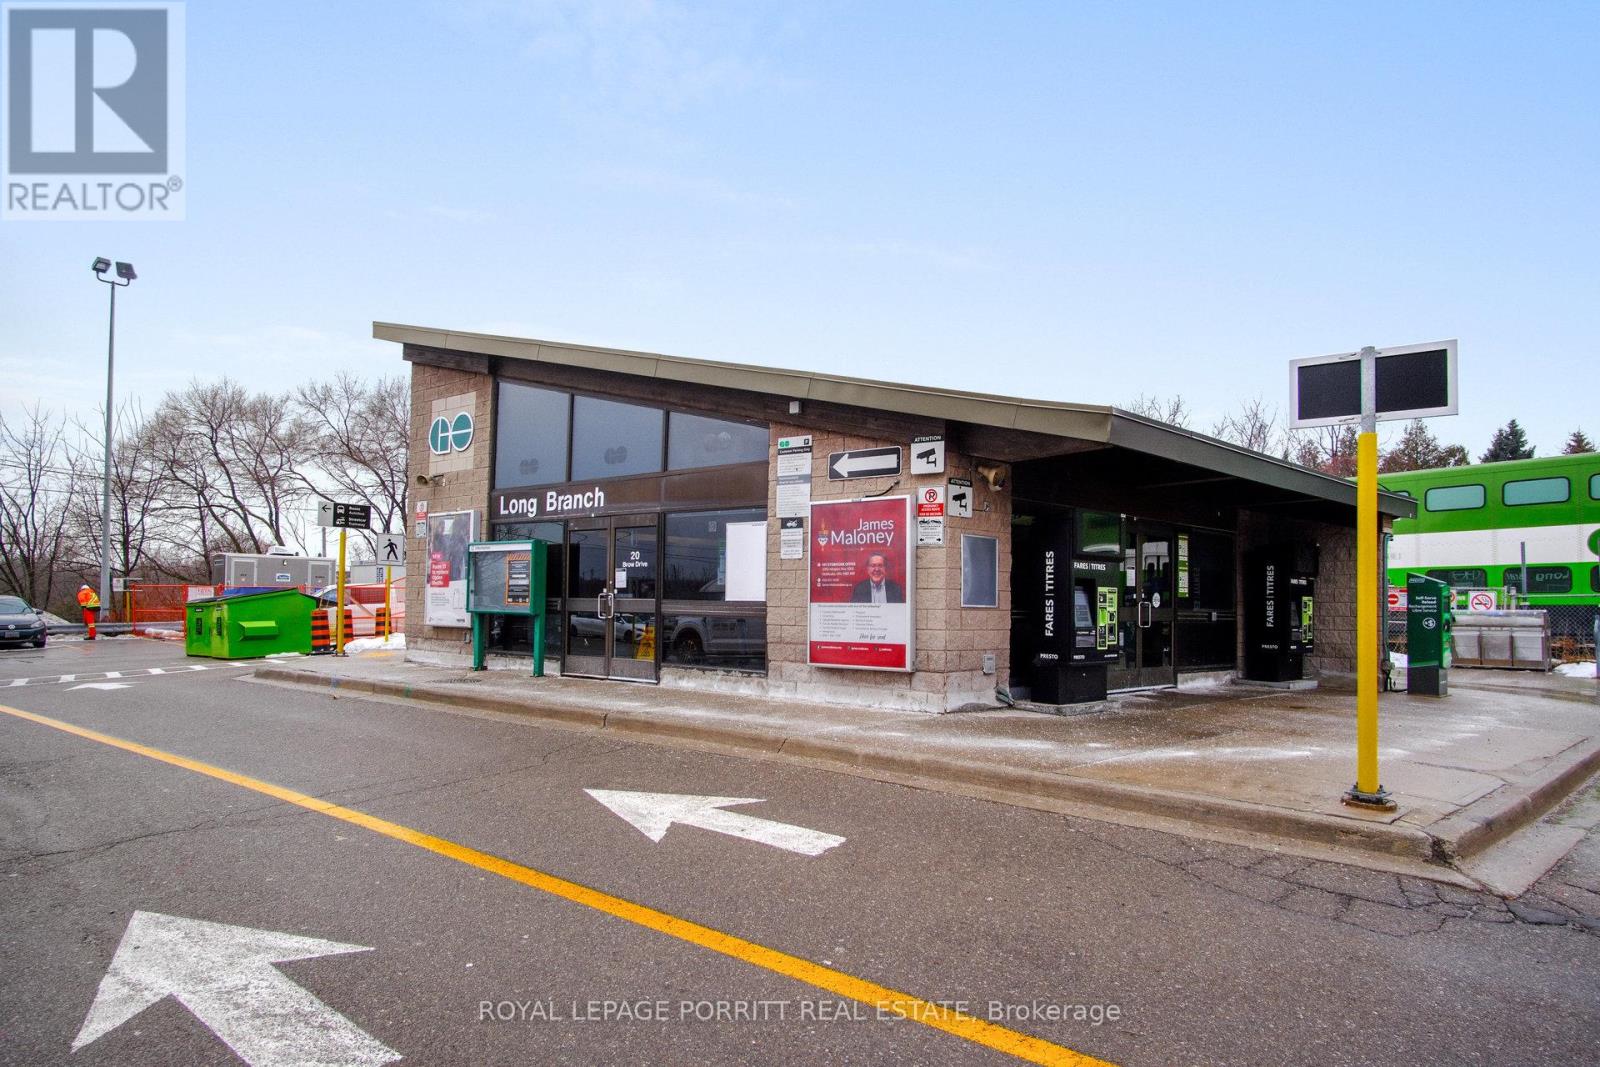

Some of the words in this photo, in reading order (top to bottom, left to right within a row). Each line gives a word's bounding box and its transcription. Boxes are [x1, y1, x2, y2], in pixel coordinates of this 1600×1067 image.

[500, 496, 537, 517] Long
[546, 487, 605, 512] Branch
[857, 518, 894, 531] James
[831, 531, 895, 547] Maloney
[630, 551, 640, 560] 20
[1091, 563, 1106, 571] TITRES
[1045, 551, 1054, 591] TITRES
[1266, 565, 1274, 595] TITRES
[1045, 599, 1054, 636] FARES
[1266, 600, 1274, 627] FARES
